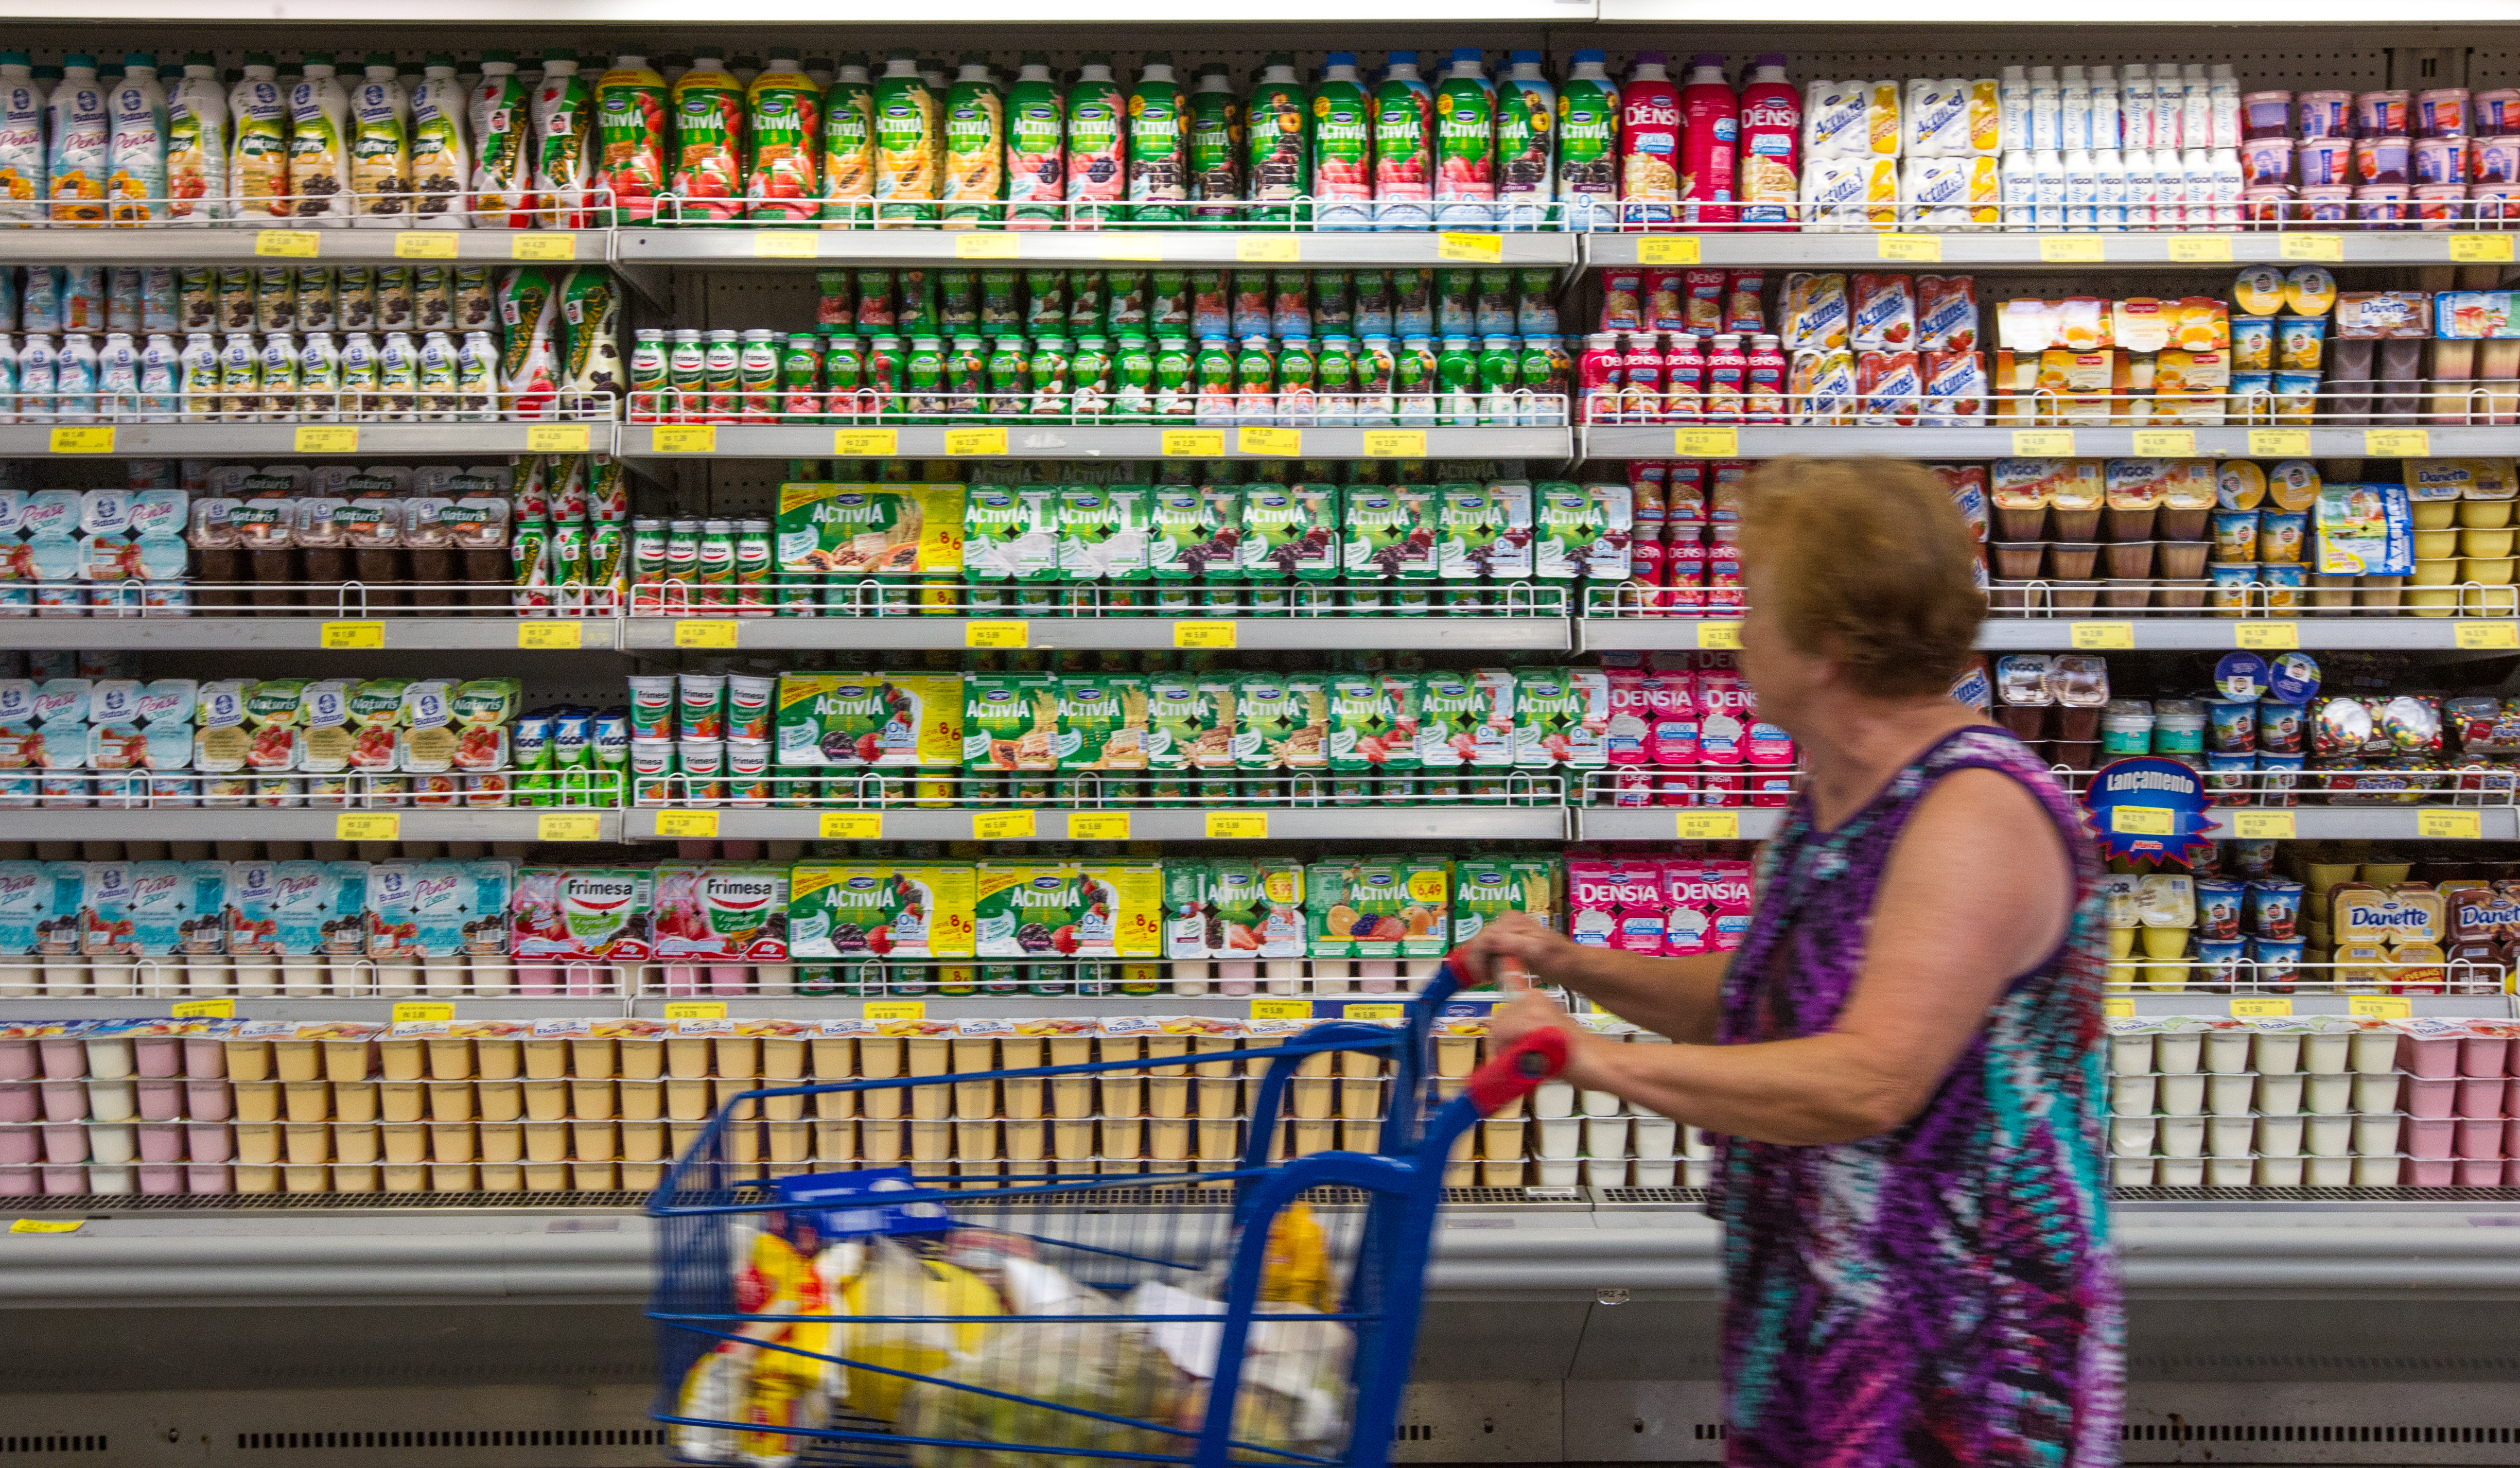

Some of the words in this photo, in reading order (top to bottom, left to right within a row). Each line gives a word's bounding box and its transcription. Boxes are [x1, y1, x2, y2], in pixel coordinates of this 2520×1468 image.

[598, 110, 643, 128] ACTIVIA
[676, 111, 724, 129] ACTIVIA
[752, 111, 801, 130] ACTIVIA
[1013, 117, 1061, 135] ACTIVIA
[1132, 118, 1179, 136] ACTIVIA
[1317, 123, 1367, 139] ACTIVIA
[1440, 120, 1490, 138] ACTIVIA
[1560, 121, 1609, 139] ACTIVIA
[113, 131, 156, 150] Pense
[2419, 466, 2471, 483] Danette
[20, 502, 65, 526] Pense
[127, 501, 173, 525] Pense
[230, 508, 278, 524] Naturis
[334, 509, 382, 522] Naturis
[440, 509, 489, 522] Naturis
[812, 503, 885, 523] ACTIVIA
[965, 505, 1030, 523] ACTIVIA
[1058, 506, 1120, 524] ACTIVIA
[1151, 506, 1215, 525] ACTIVIA
[1242, 505, 1306, 524] ACTIVIA
[1345, 506, 1410, 526] ACTIVIA
[1440, 505, 1503, 526] ACTIVIA
[1539, 505, 1602, 526] ACTIVIA
[940, 531, 950, 544] 8
[952, 537, 962, 550] 6
[32, 692, 77, 715] Pense
[248, 697, 300, 711] Naturis
[351, 697, 399, 710] Naturis
[452, 697, 502, 710] Naturis
[638, 691, 669, 701] Frimesa
[683, 690, 714, 700] Frimesa
[734, 690, 765, 700] Frimesa
[1422, 693, 1485, 713] ACTIVIA
[1516, 694, 1580, 714] ACTIVIA
[1612, 689, 1693, 708] DENSIA
[135, 694, 180, 716] Pense
[814, 695, 884, 715] ACTIVIA
[966, 699, 1030, 719] ACTIVIA
[1057, 698, 1120, 717] ACTIVIA
[1147, 698, 1210, 716] ACTIVIA
[1237, 698, 1300, 716] ACTIVIA
[1331, 696, 1393, 715] ACTIVIA
[939, 722, 949, 735] 8
[951, 728, 961, 741] 6
[688, 757, 718, 766] Frimesa
[732, 757, 763, 766] Frimesa
[2106, 771, 2195, 794] Lançamento
[132, 875, 177, 898] Pense
[276, 876, 319, 898] Pense
[413, 877, 457, 902] Pense
[568, 879, 633, 896] Frimesa
[707, 879, 772, 896] Frimesa
[1207, 884, 1267, 901] ACTIVIA
[1351, 883, 1411, 901] ACTIVIA
[1417, 883, 1442, 898] 6,49
[1459, 883, 1521, 901] ACTIVIA
[1579, 883, 1658, 903] DENSIA
[1672, 882, 1750, 901] DENSIA
[825, 887, 896, 907] ACTIVIA
[1010, 887, 1081, 907] ACTIVIA
[950, 914, 960, 927] 8
[1135, 914, 1146, 927] 8
[2352, 907, 2428, 926] Danette
[2461, 906, 2520, 925] Danet
[962, 920, 972, 933] 6
[1147, 920, 1158, 933] 6
